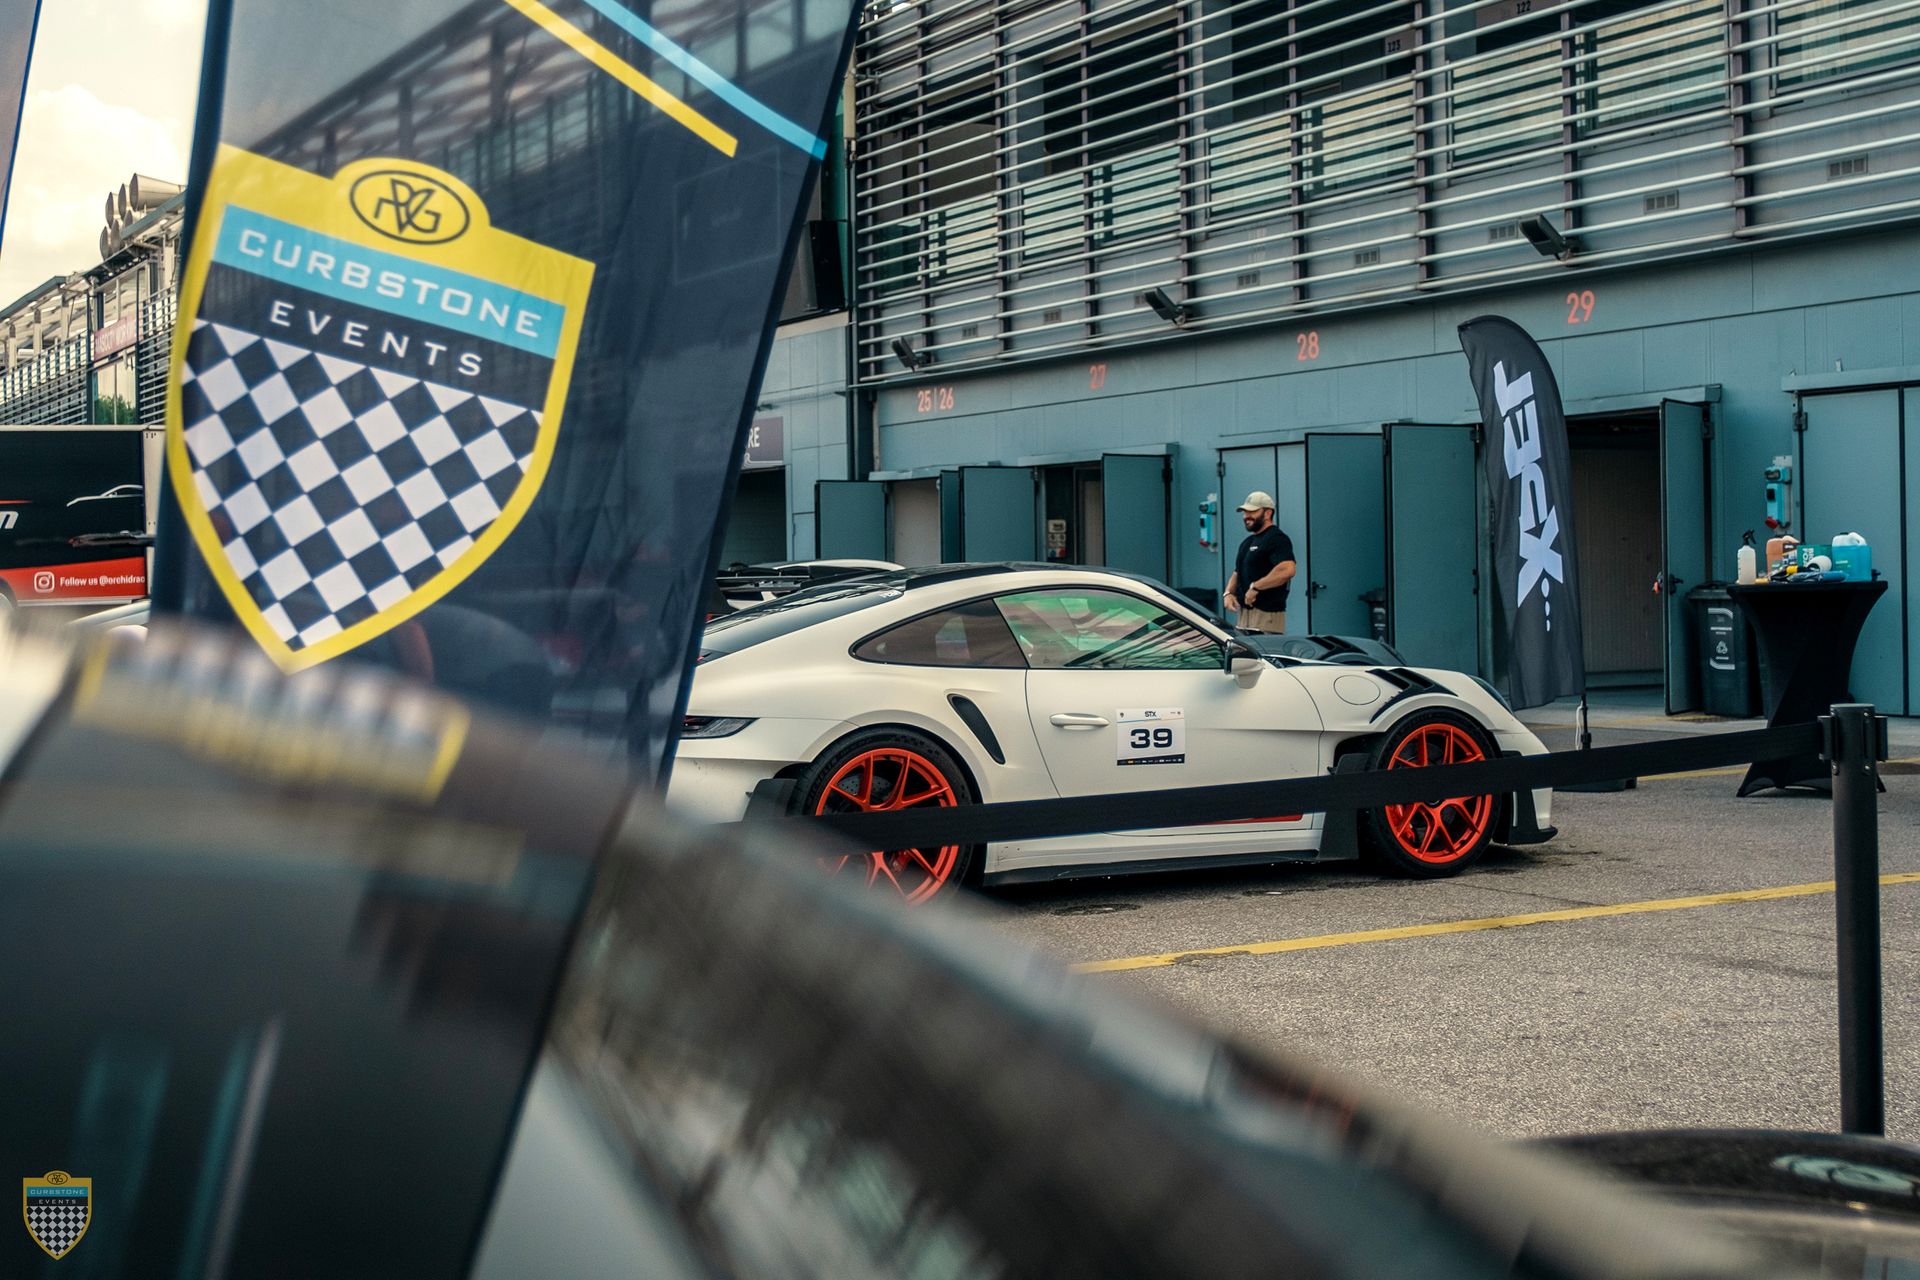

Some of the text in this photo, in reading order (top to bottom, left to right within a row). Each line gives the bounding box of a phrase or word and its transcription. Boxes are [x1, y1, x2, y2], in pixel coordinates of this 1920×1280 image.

[239, 228, 542, 338] CURBSTONE
[1566, 290, 1595, 324] 29
[270, 299, 483, 377] EVENTS
[1296, 331, 1319, 361] 28
[1089, 364, 1106, 389] 27
[60, 576, 87, 586] Follow
[88, 577, 98, 586] us
[1130, 728, 1173, 749] 39
